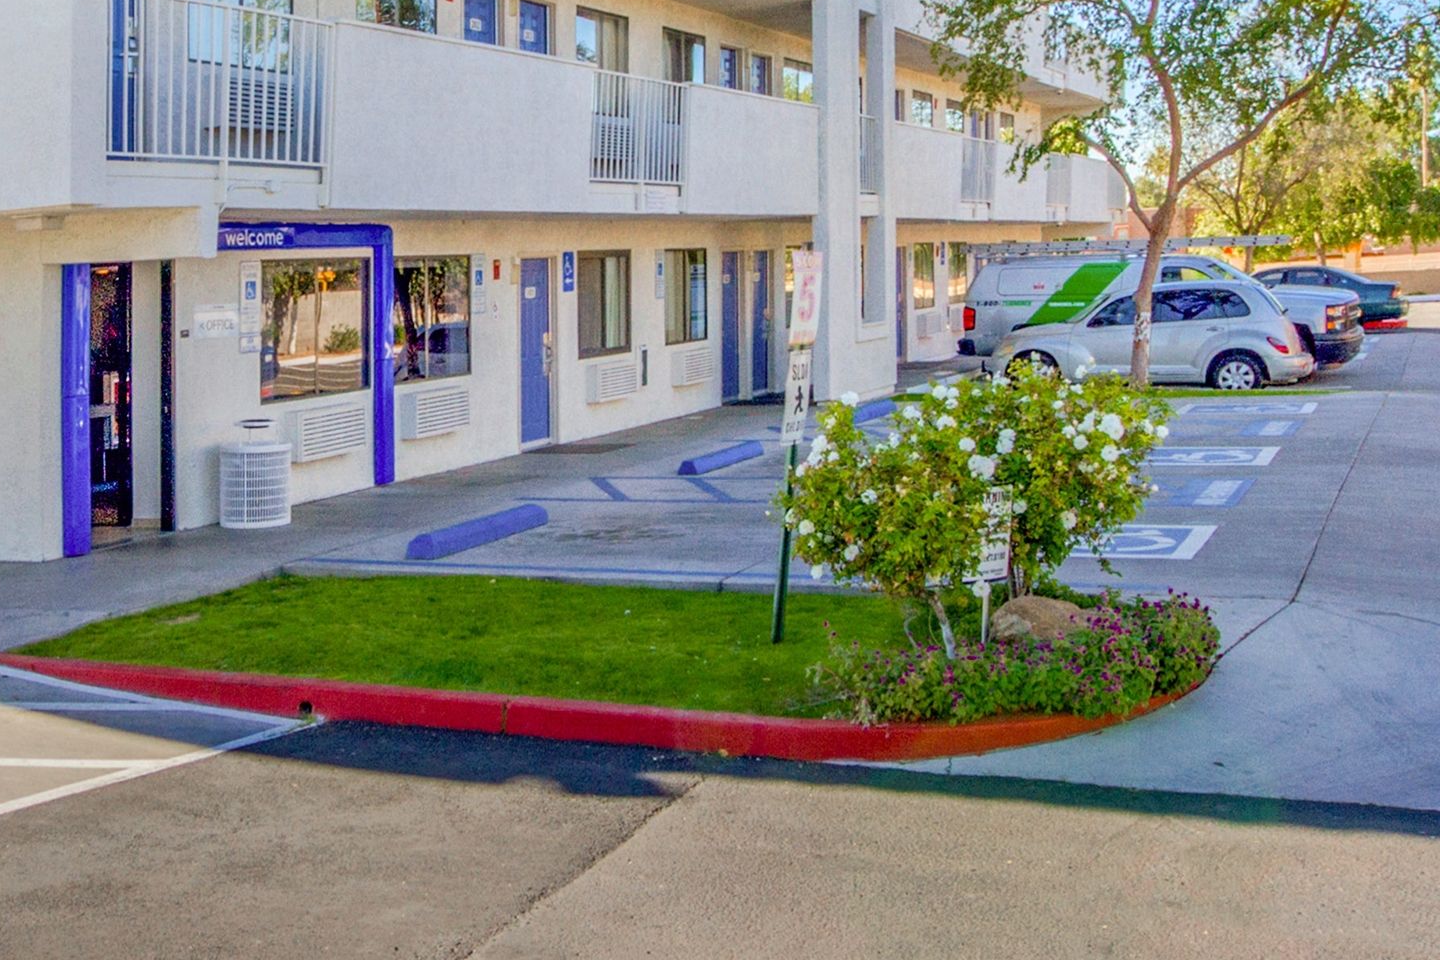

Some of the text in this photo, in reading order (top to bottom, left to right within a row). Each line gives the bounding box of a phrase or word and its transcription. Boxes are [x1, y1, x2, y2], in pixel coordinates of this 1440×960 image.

[224, 228, 285, 246] welcome
[799, 275, 817, 321] 5
[206, 318, 235, 332] OFFICE
